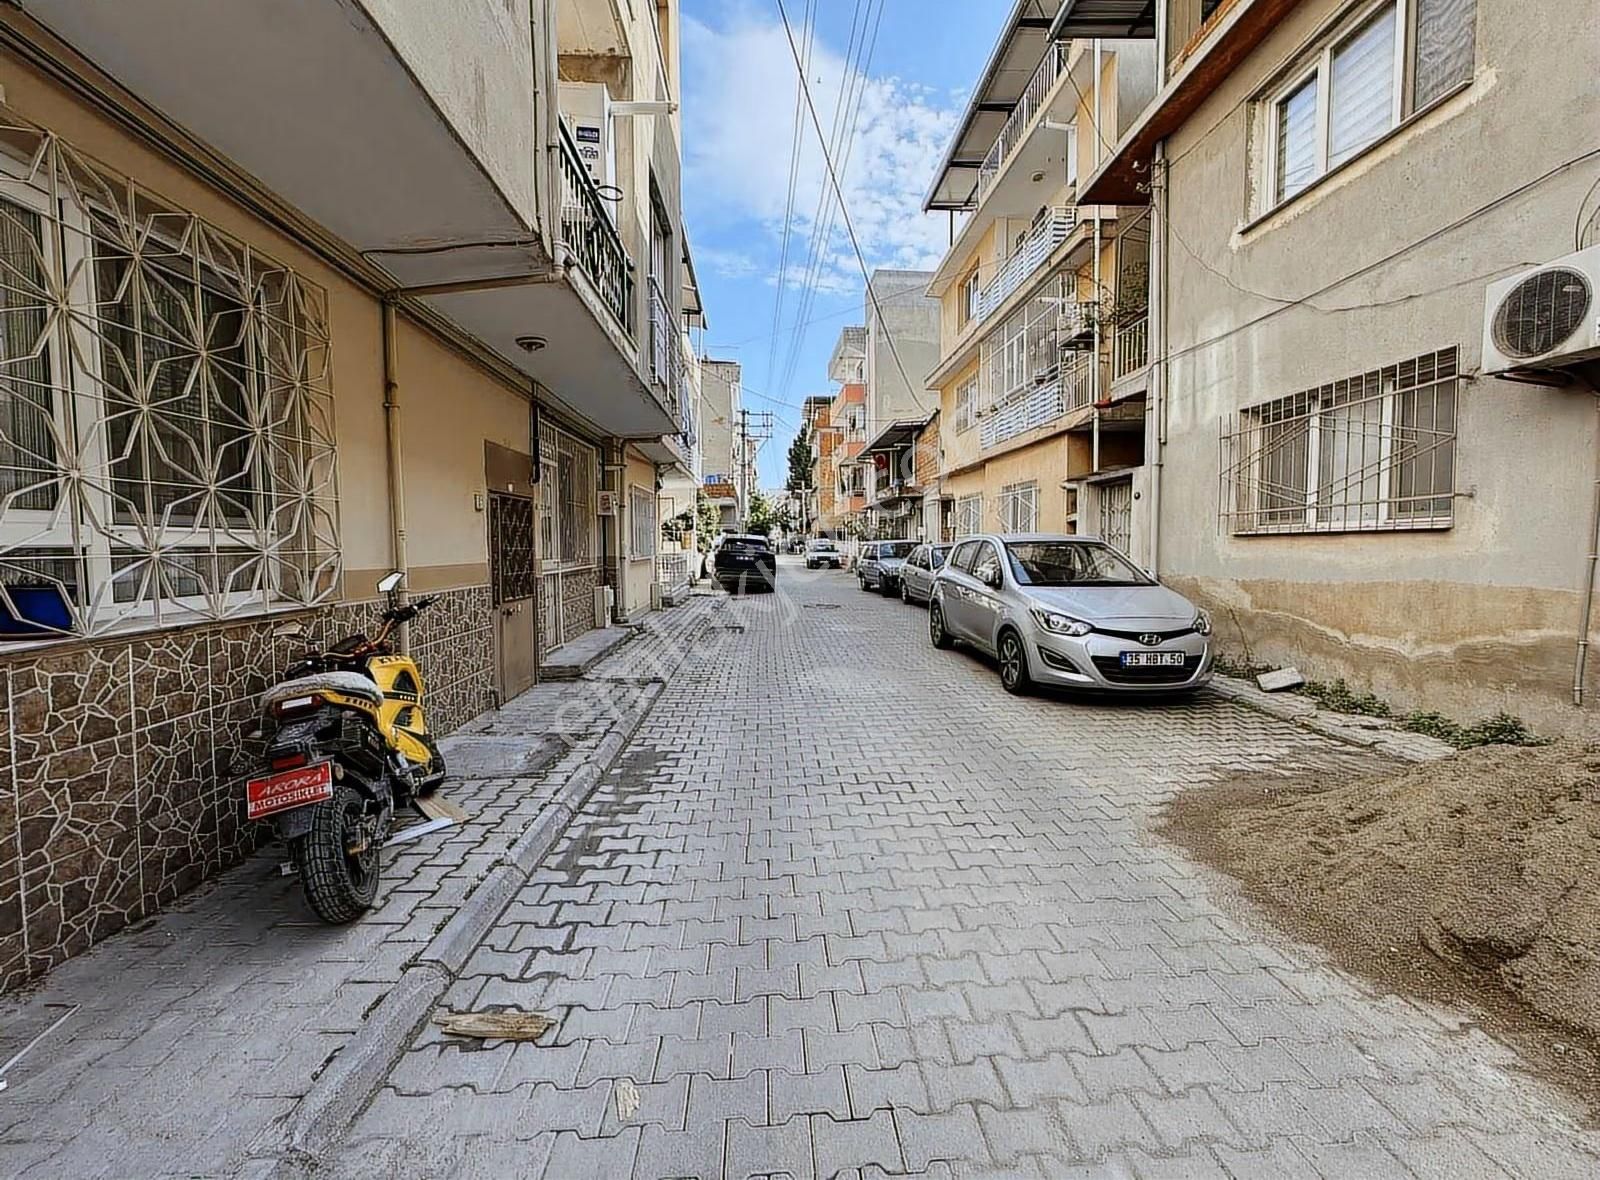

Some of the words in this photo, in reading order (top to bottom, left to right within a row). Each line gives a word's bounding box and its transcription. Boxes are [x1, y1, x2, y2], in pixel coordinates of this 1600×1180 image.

[1127, 653, 1140, 664] 35
[1145, 653, 1164, 664] HBT
[1170, 653, 1183, 664] 50
[252, 785, 328, 811] MOTOSIKLET
